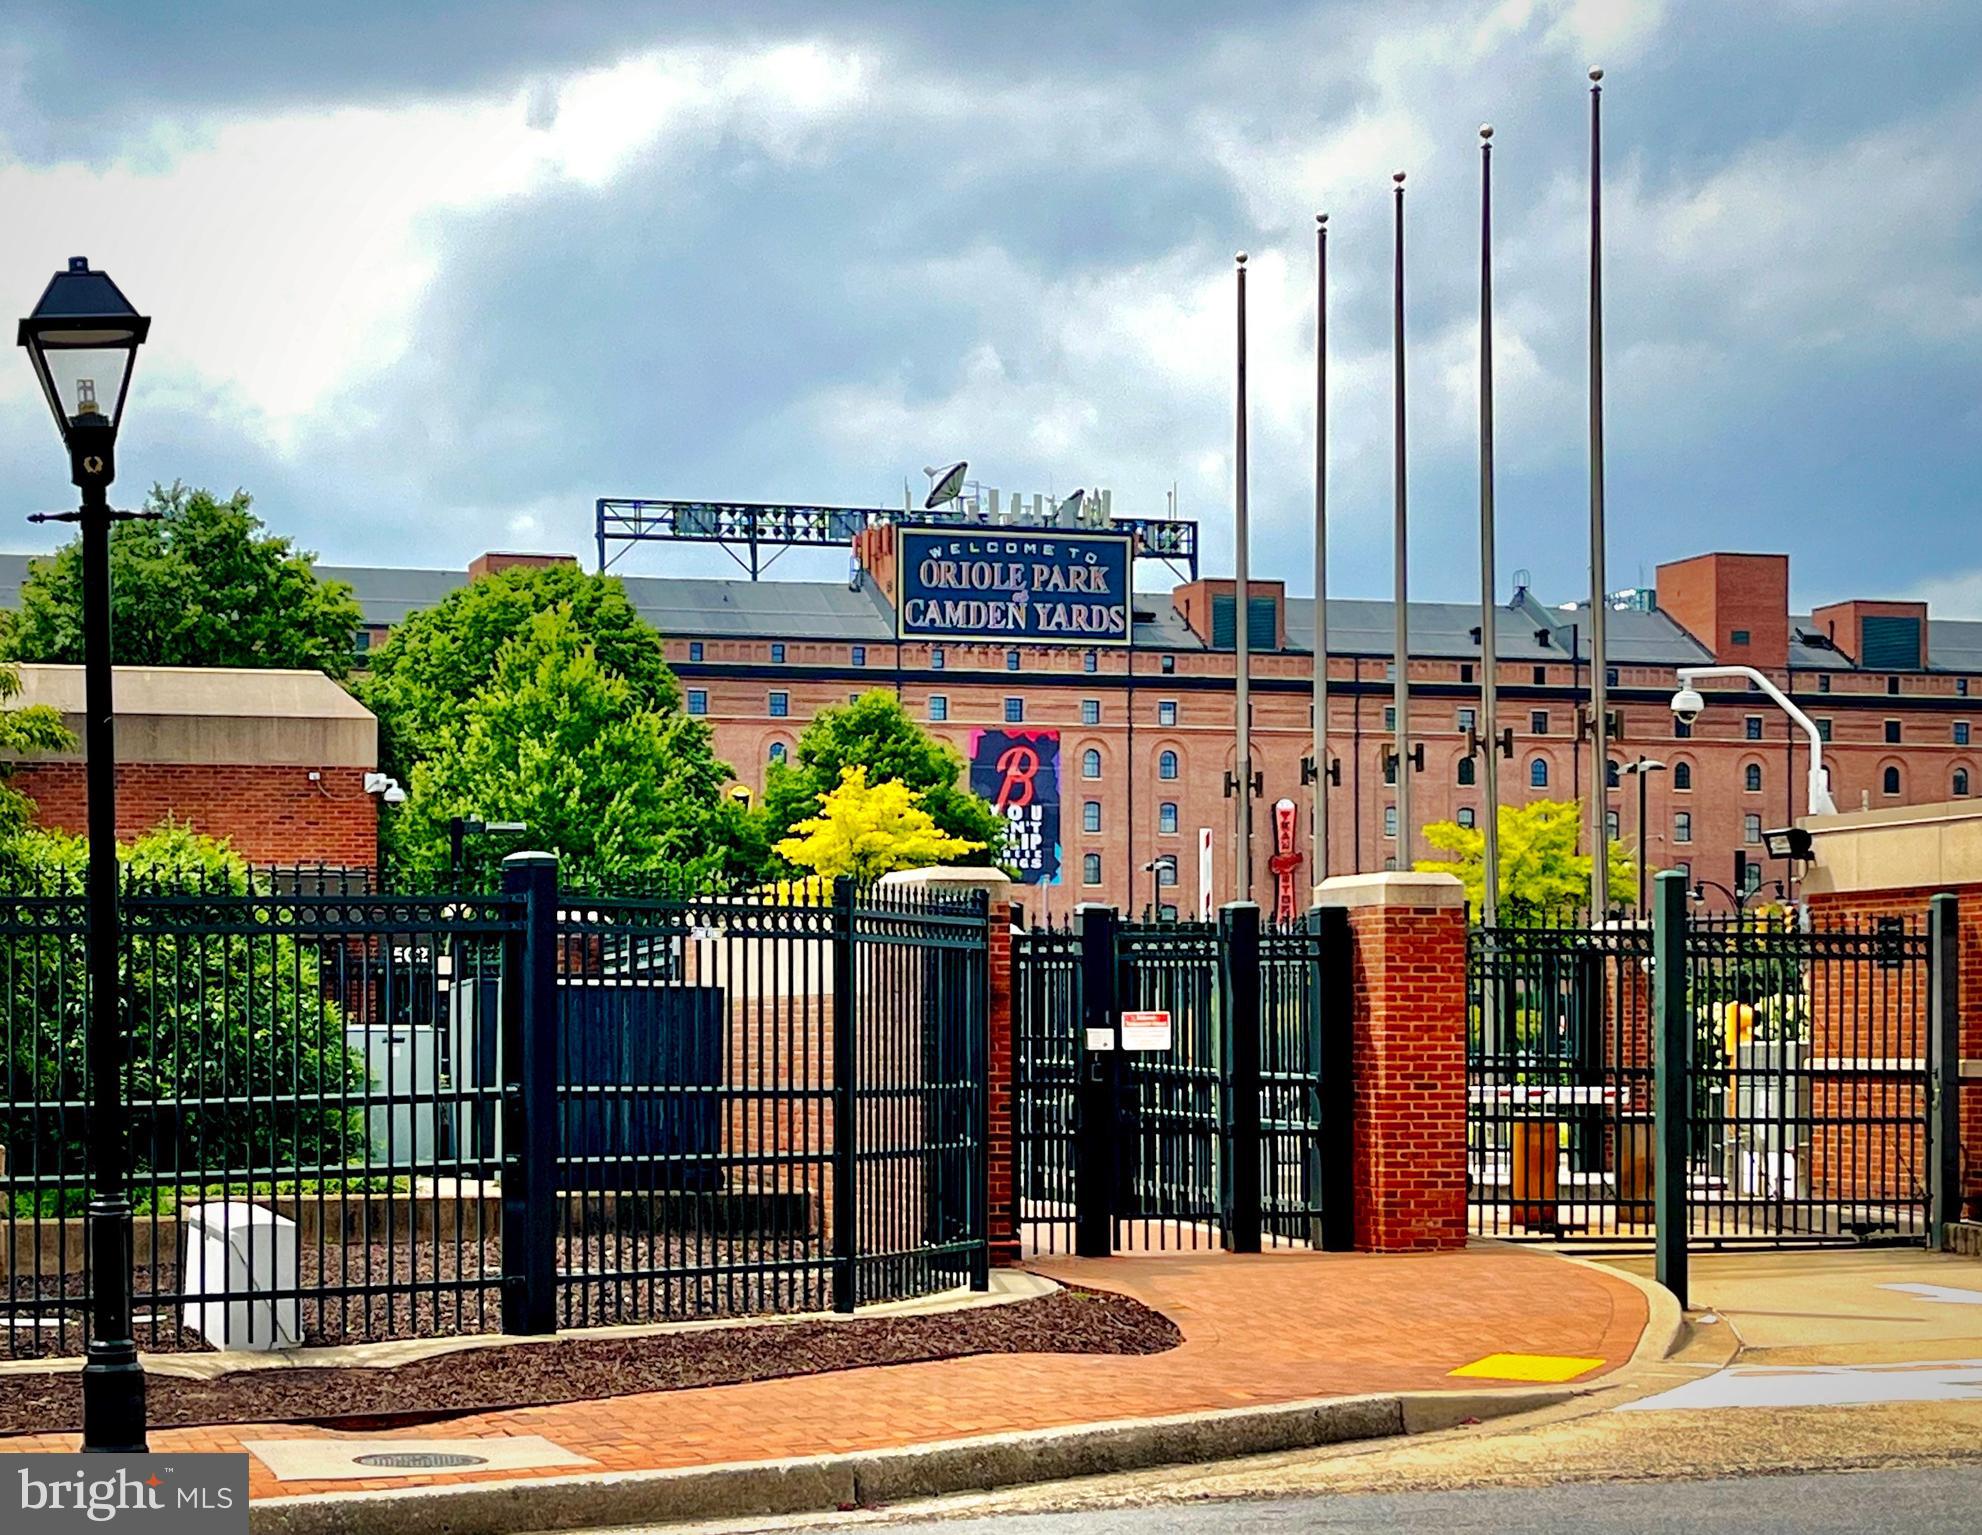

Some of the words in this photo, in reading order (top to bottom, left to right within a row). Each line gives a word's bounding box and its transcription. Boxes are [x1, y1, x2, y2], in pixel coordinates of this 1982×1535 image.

[929, 541, 1055, 559] WELCOME
[1069, 547, 1098, 564] TO
[919, 559, 1027, 590] ORIOLE
[1031, 564, 1110, 594] PARK
[905, 598, 1028, 630] CAMDEN
[1033, 602, 1125, 633] YARDS
[996, 745, 1041, 811] B
